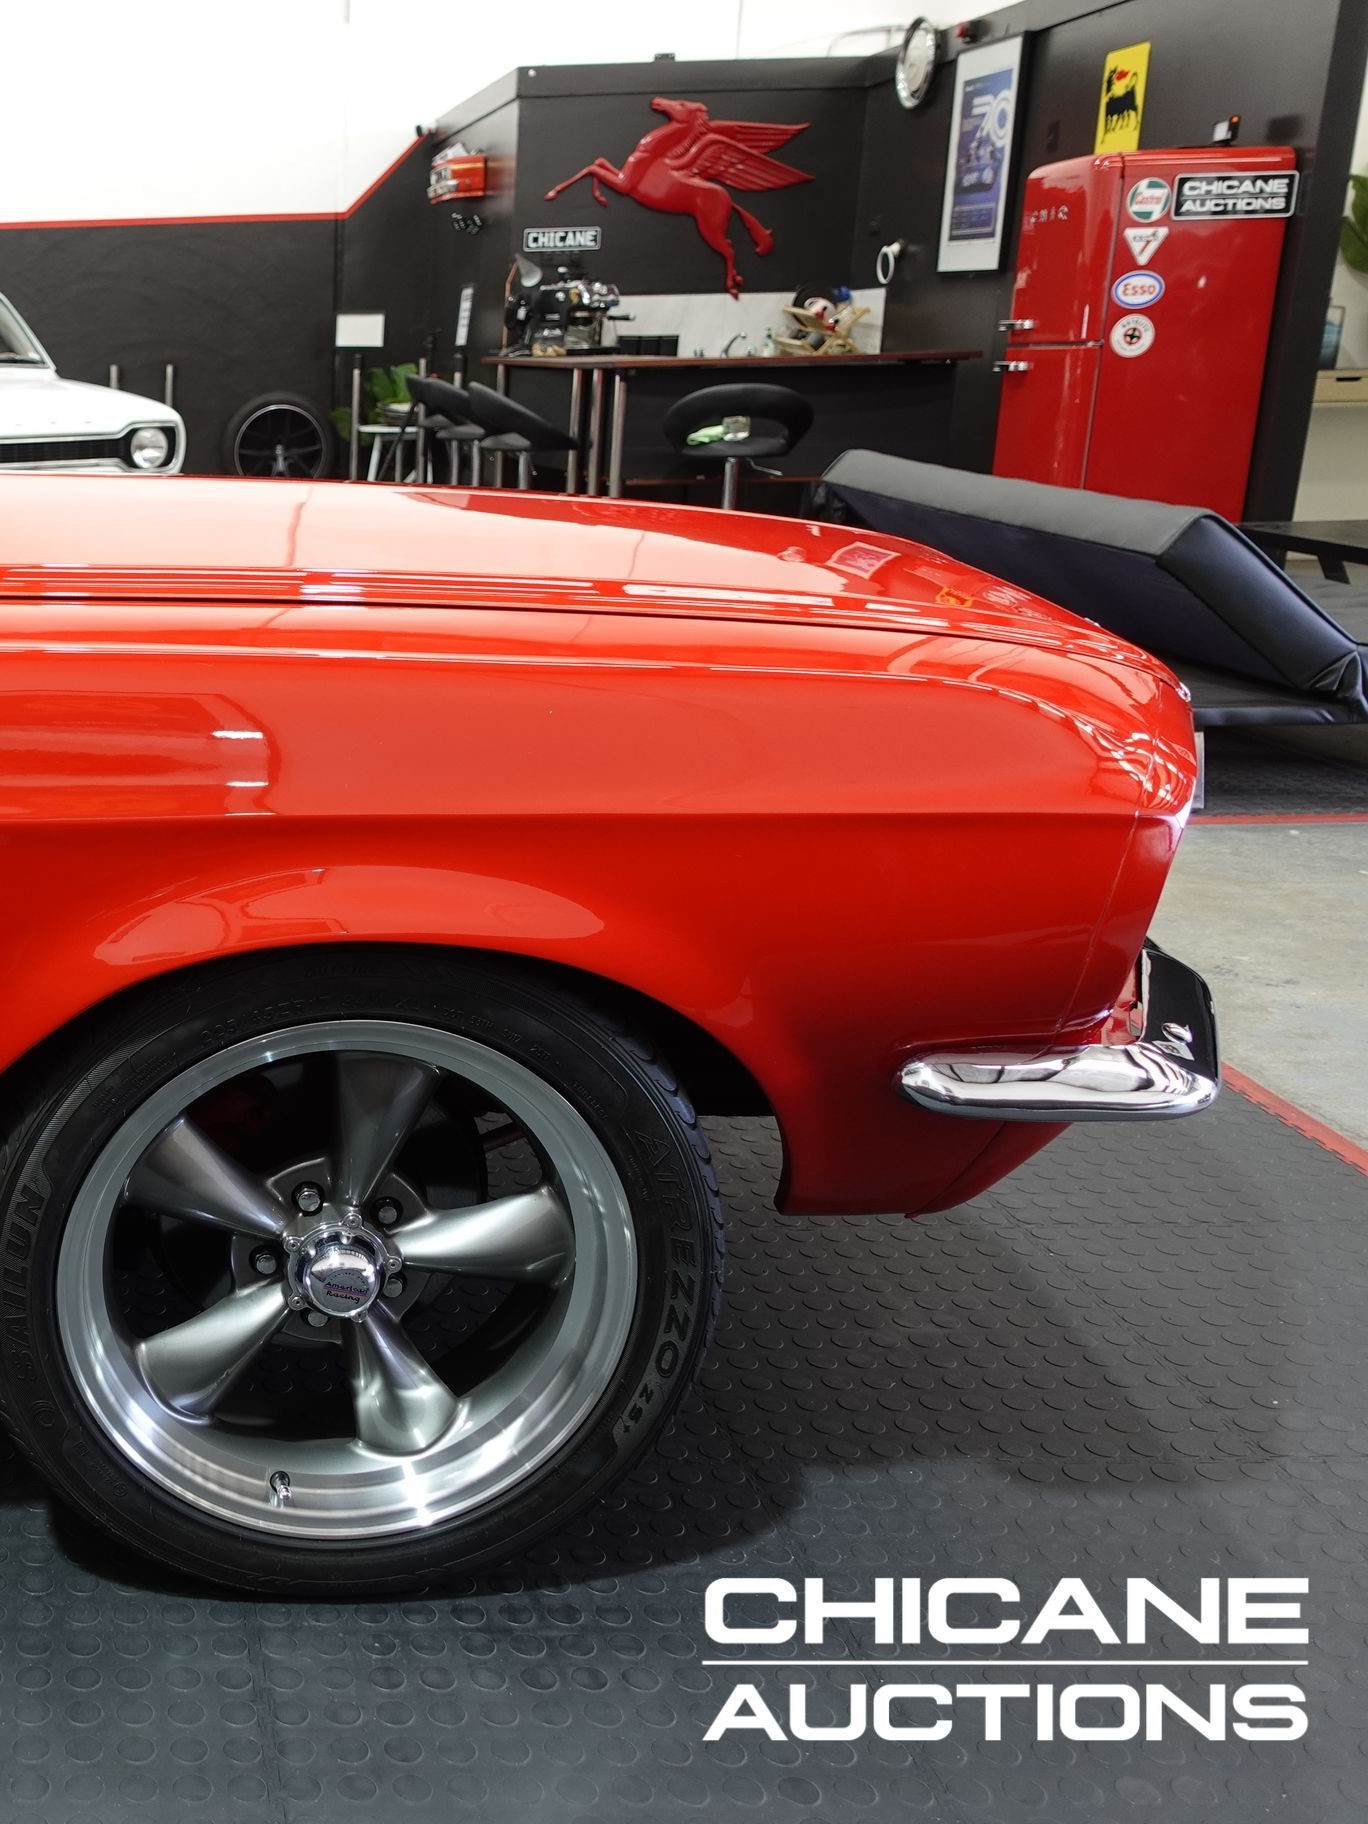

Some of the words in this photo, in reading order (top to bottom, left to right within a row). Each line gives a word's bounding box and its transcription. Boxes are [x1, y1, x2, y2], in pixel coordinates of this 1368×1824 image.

[1182, 178, 1289, 196] CHICANE
[1180, 197, 1286, 213] AUCTIONS
[527, 230, 597, 248] CHICANE
[632, 1129, 698, 1378] ATREZZO
[3, 1183, 45, 1383] SAILUN
[326, 1291, 361, 1304] Racing
